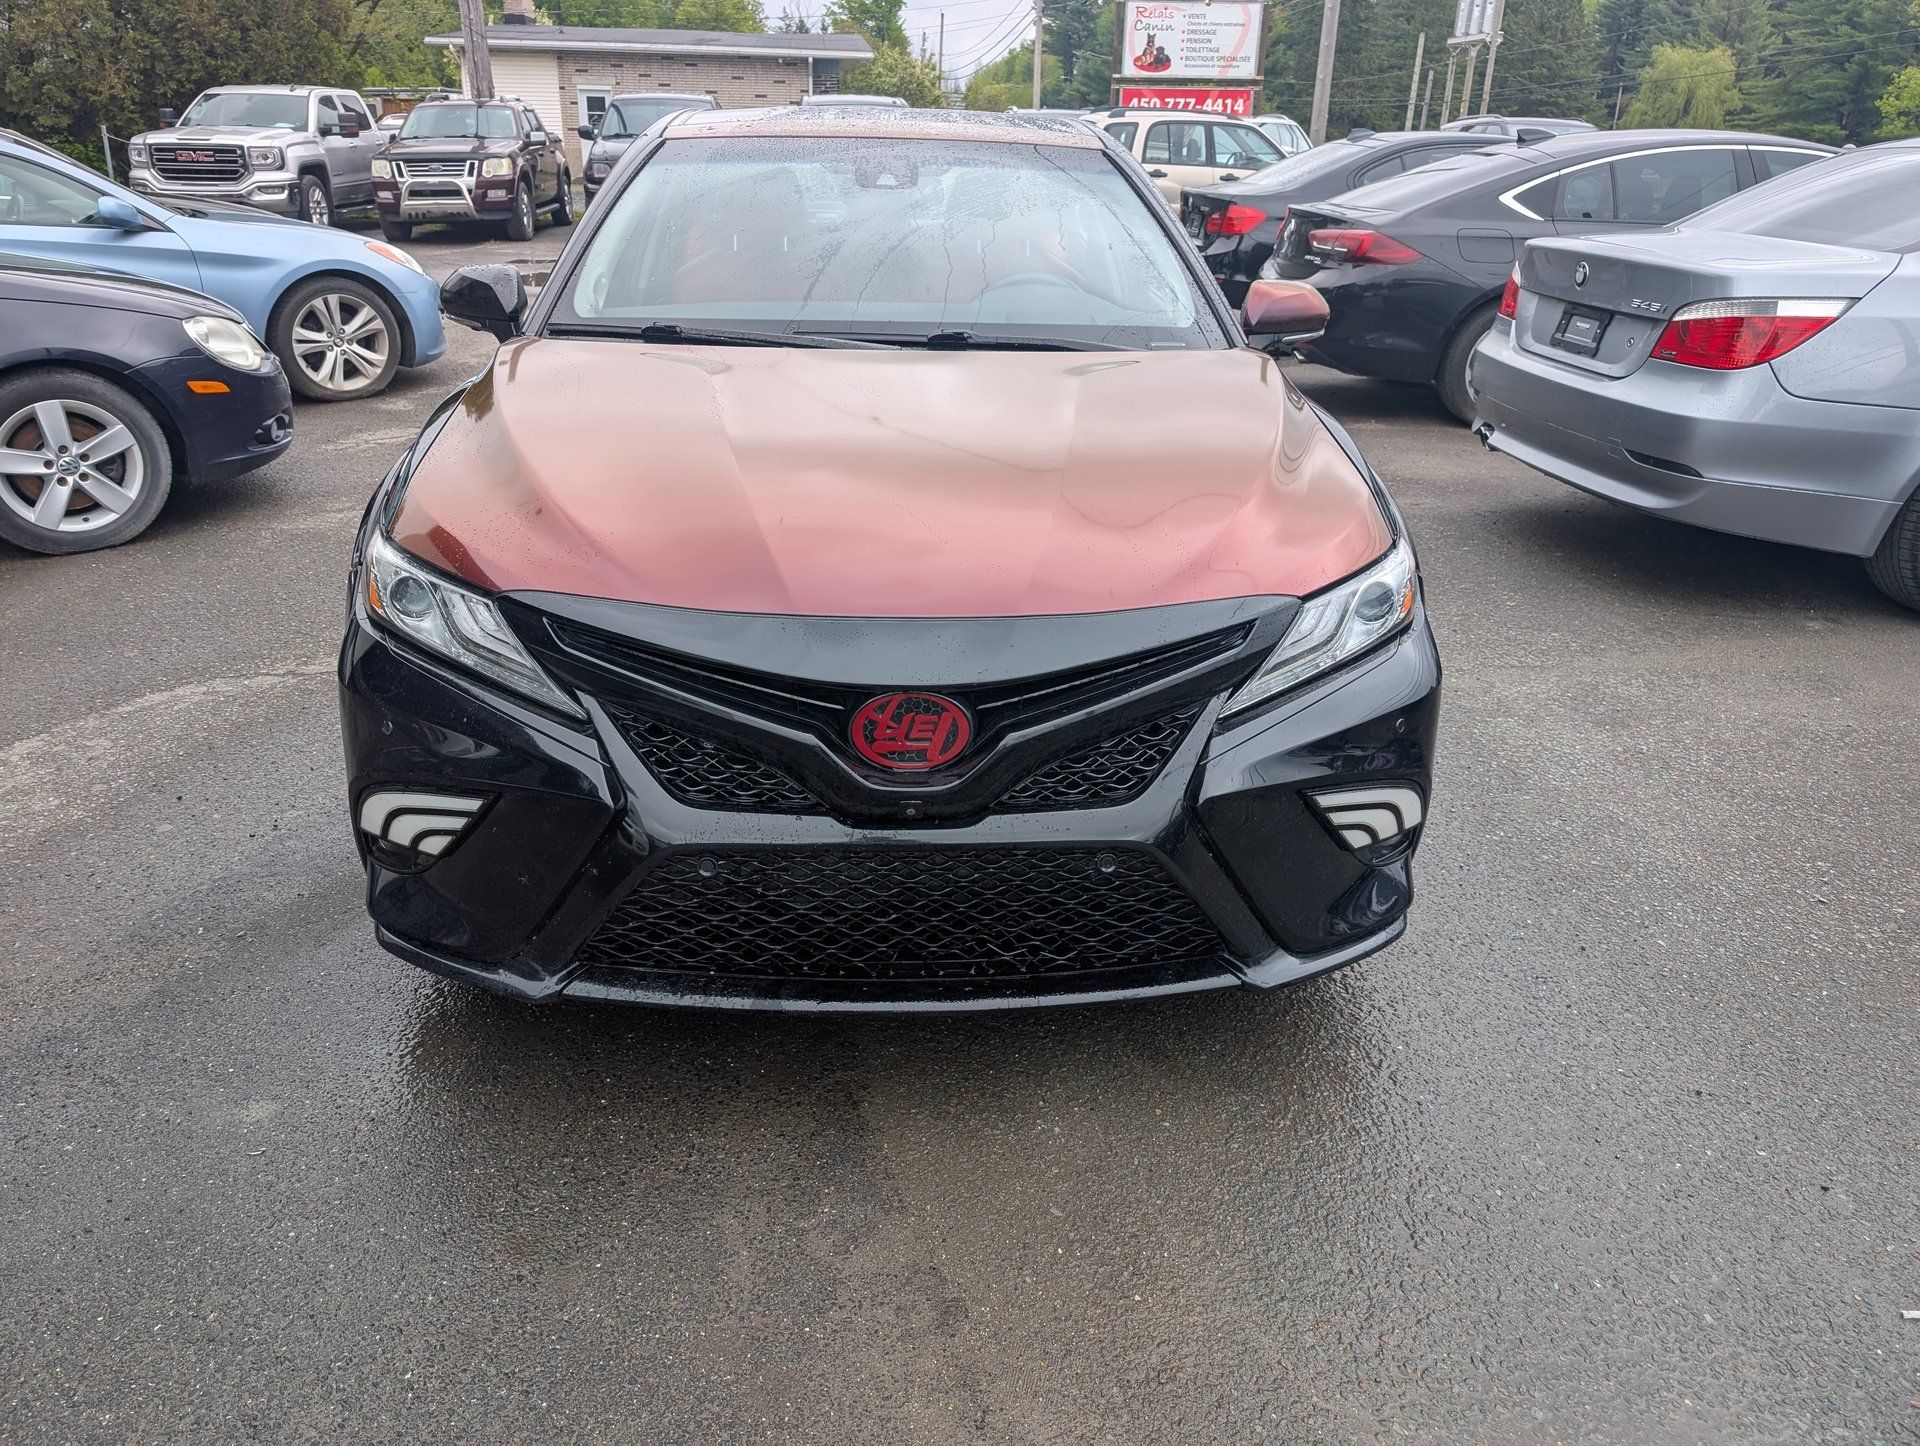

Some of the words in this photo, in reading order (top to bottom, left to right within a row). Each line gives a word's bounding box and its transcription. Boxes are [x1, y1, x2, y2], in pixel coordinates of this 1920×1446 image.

[1134, 6, 1175, 19] Relais
[1134, 19, 1175, 32] Canin
[1128, 98, 1160, 108] 450
[1164, 98, 1244, 114] 777-4414
[175, 150, 215, 162] GMC
